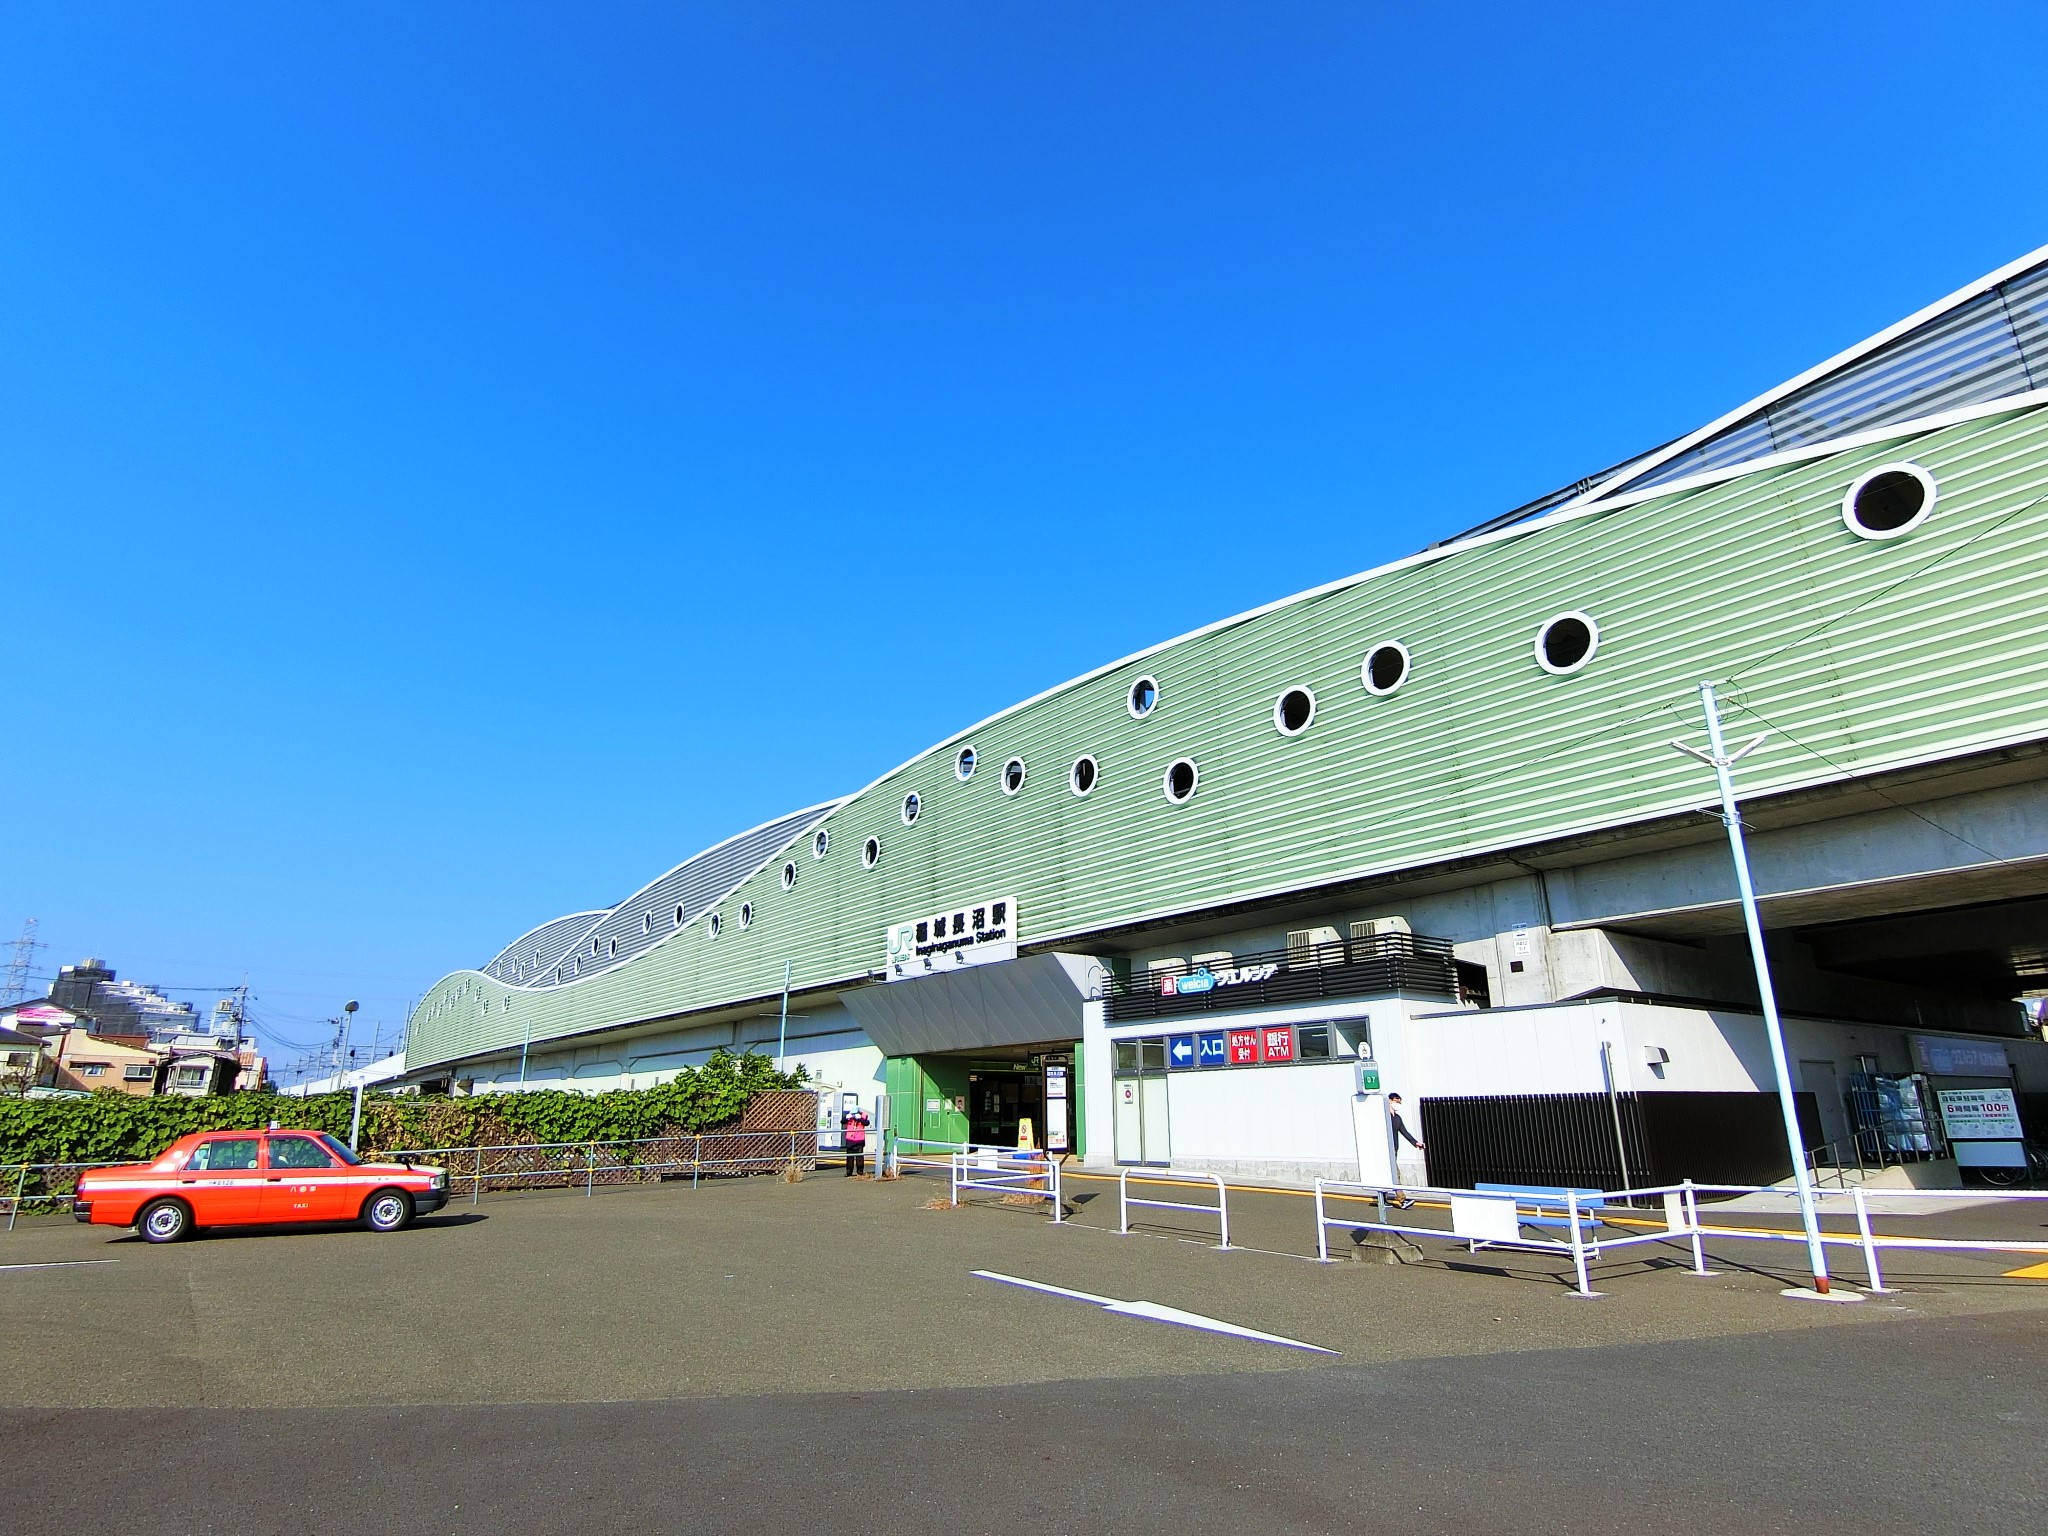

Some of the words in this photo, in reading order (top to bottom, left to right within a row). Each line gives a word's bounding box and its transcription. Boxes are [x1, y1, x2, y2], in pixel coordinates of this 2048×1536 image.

[916, 902, 1006, 943] 稲城長沼駅
[888, 926, 913, 954] JR
[976, 928, 1006, 943] Station
[1232, 1034, 1256, 1047] 処方せん
[1266, 1031, 1289, 1047] 銀行
[1200, 1039, 1224, 1056] 入口
[1238, 1047, 1250, 1060] 受付
[1268, 1046, 1289, 1057] ATM
